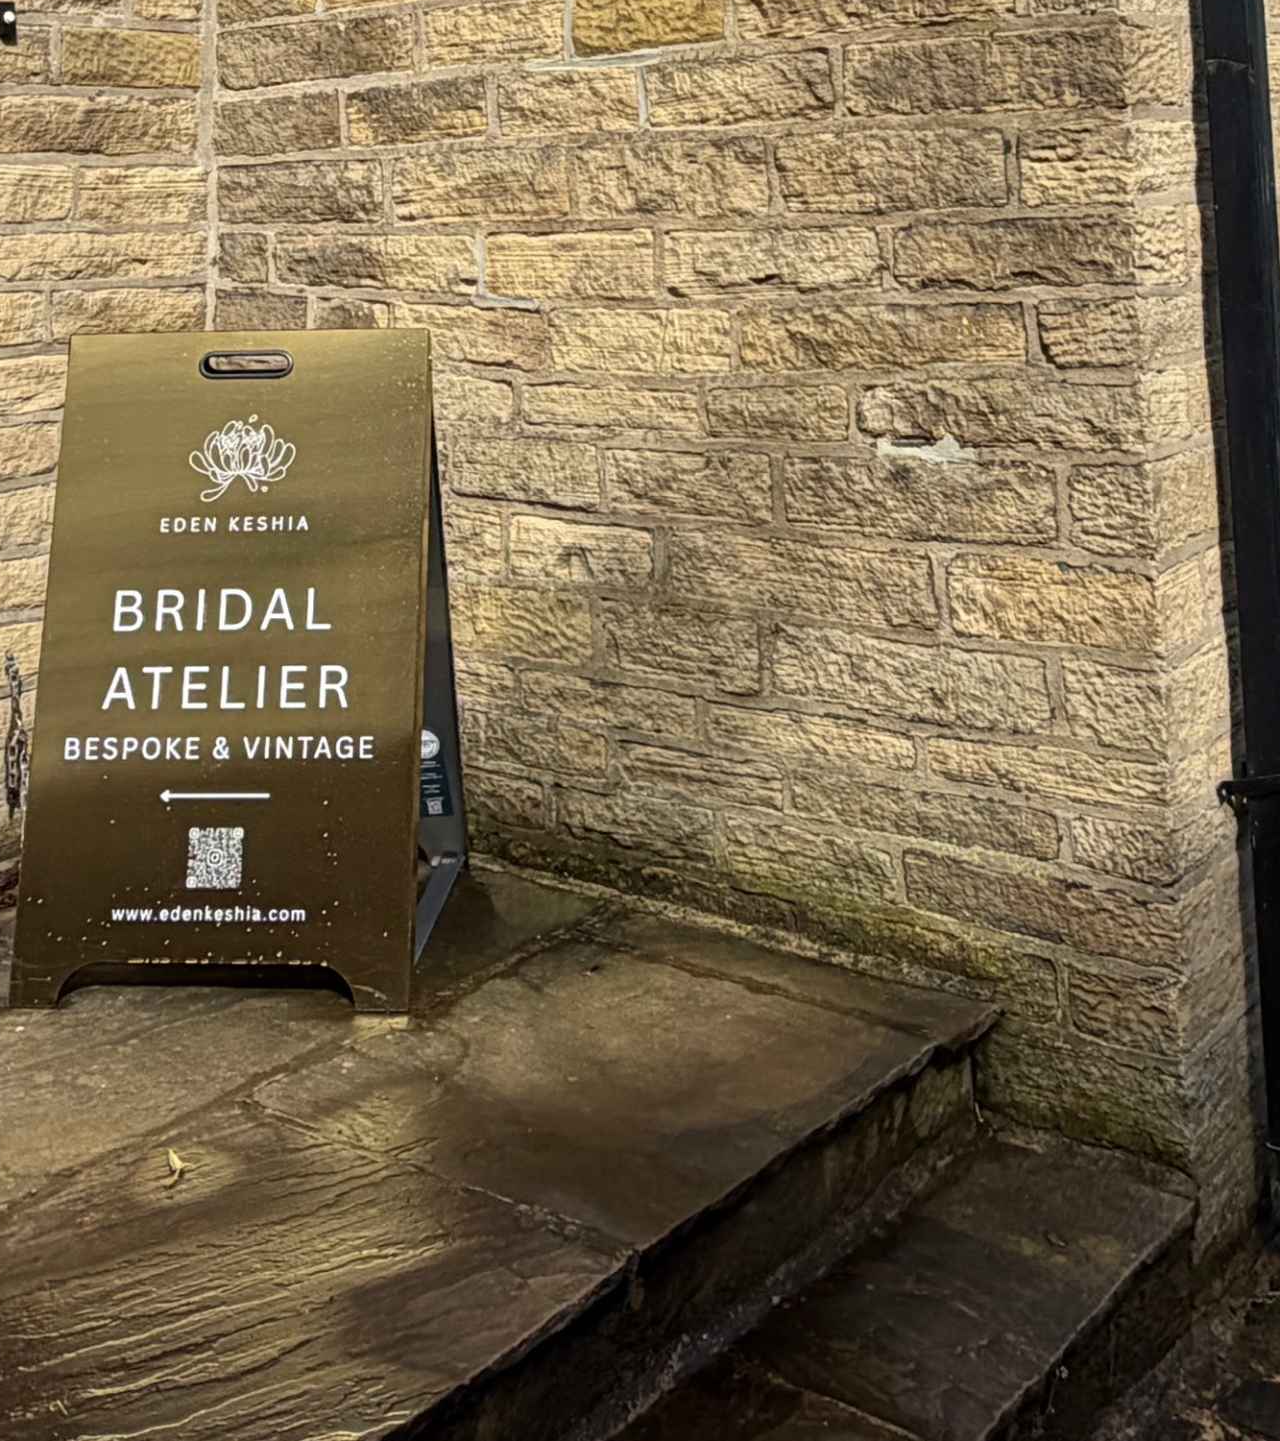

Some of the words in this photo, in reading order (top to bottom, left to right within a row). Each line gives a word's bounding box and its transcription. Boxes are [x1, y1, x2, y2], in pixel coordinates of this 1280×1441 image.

[160, 517, 217, 533] EDEN
[229, 515, 310, 532] KESHIA
[113, 587, 332, 632] BRIDAL
[101, 665, 349, 710] ATELIER
[64, 736, 201, 760] BESPOKE
[212, 736, 230, 759] &
[243, 735, 375, 759] VINTAGE
[111, 905, 306, 922] www.edenkeshia.com
